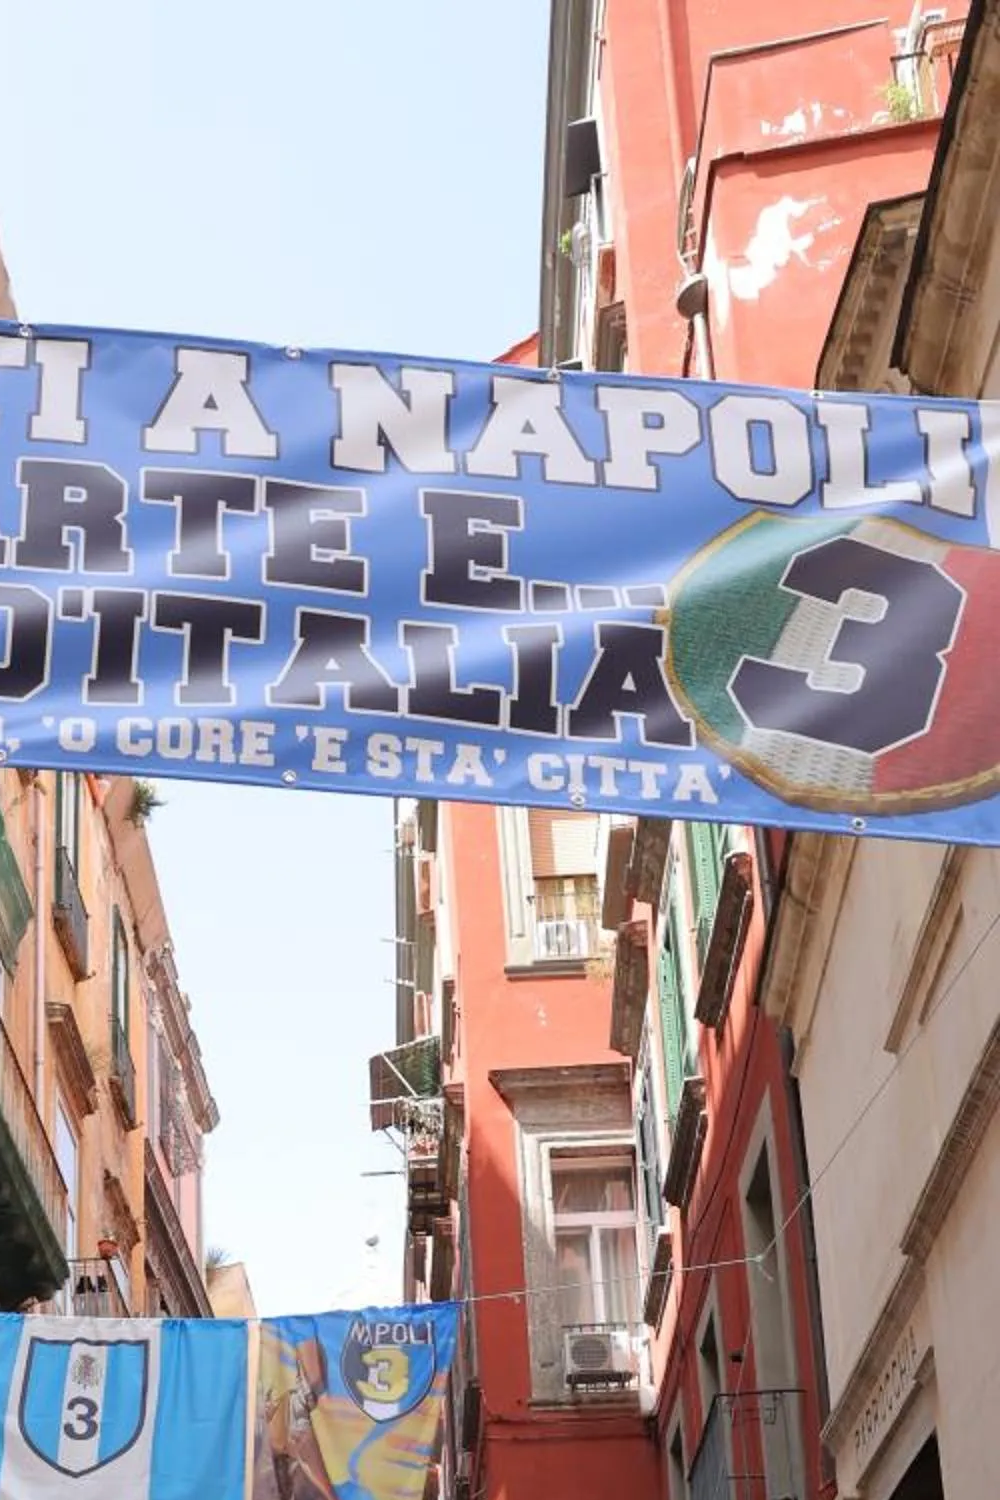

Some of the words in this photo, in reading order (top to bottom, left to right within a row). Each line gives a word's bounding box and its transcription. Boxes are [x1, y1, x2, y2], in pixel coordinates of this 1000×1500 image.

[142, 345, 279, 459] A
[328, 362, 977, 520] NAPOLI
[420, 487, 668, 615] E...
[726, 533, 968, 758] 3
[116, 716, 276, 768] CORE
[366, 731, 508, 788] STA'
[527, 749, 734, 804] CITTA'
[64, 1396, 98, 1441] 3
[355, 1347, 409, 1402] 3
